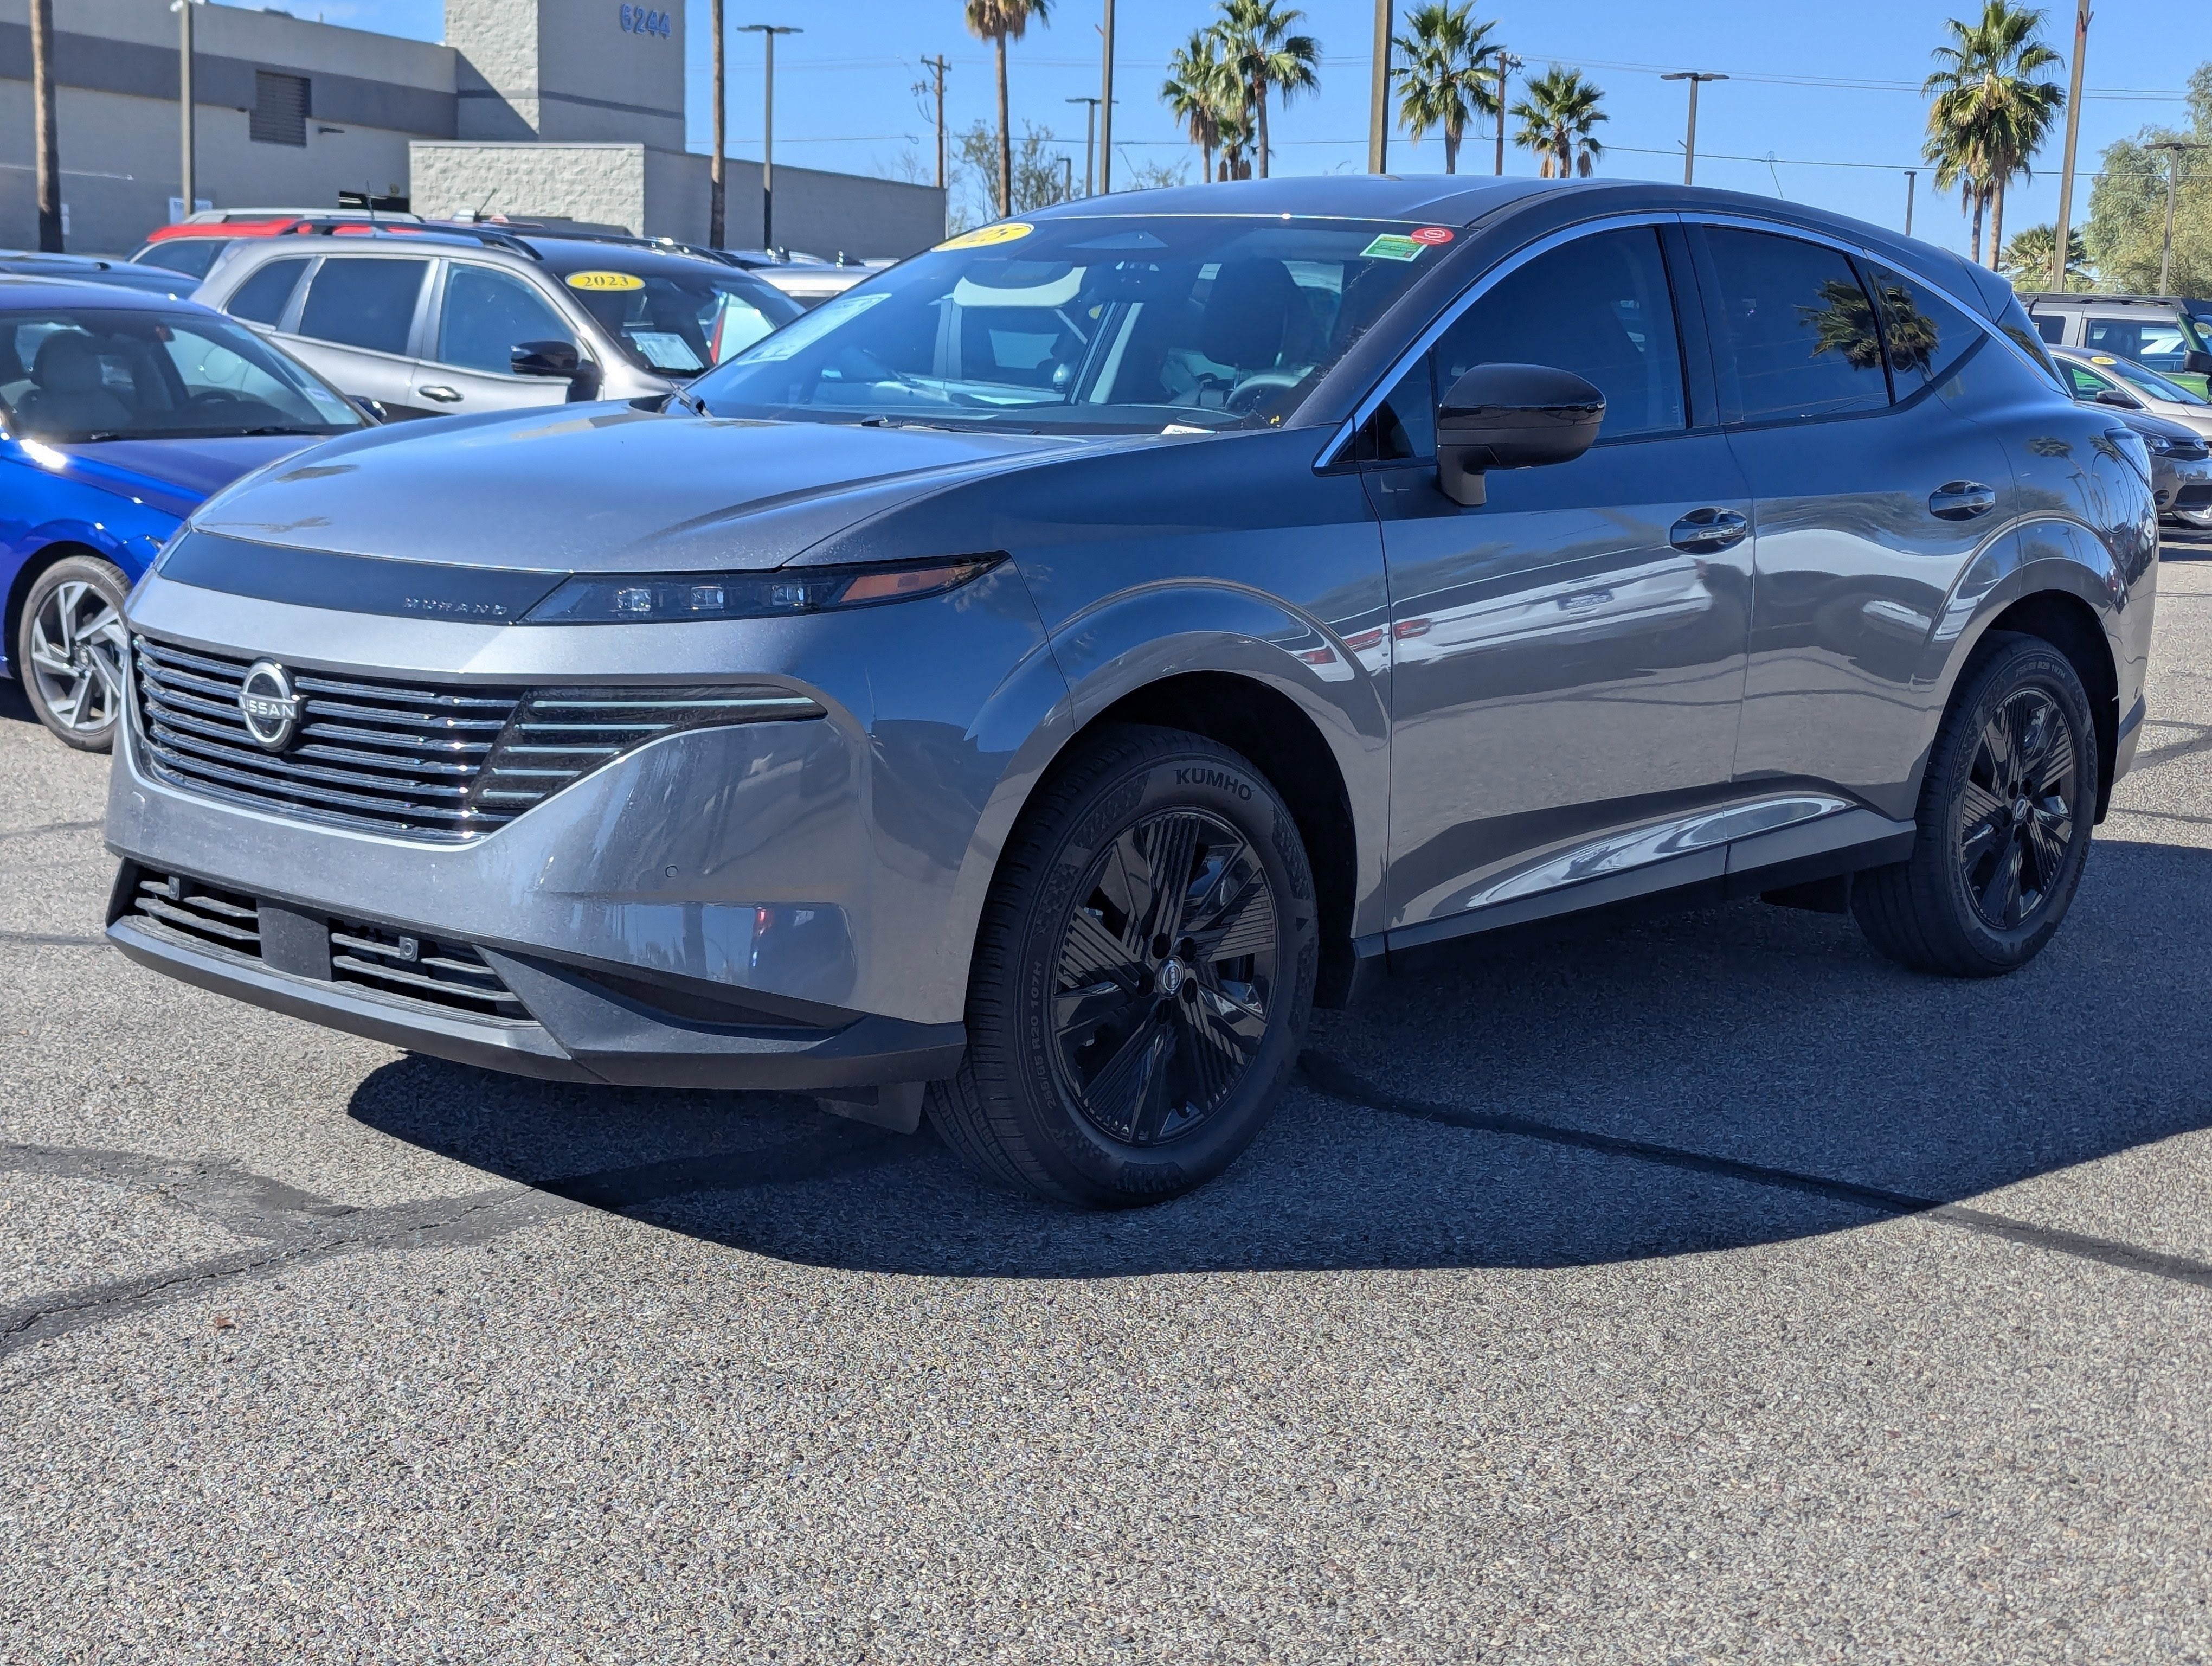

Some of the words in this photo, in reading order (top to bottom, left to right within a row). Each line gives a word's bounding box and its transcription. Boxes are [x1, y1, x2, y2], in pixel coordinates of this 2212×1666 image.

[620, 3, 672, 39] 6244
[582, 276, 629, 287] 2023
[239, 695, 295, 717] NISSAN
[1176, 768, 1252, 801] KUMHO
[1031, 961, 1043, 1010] 107H
